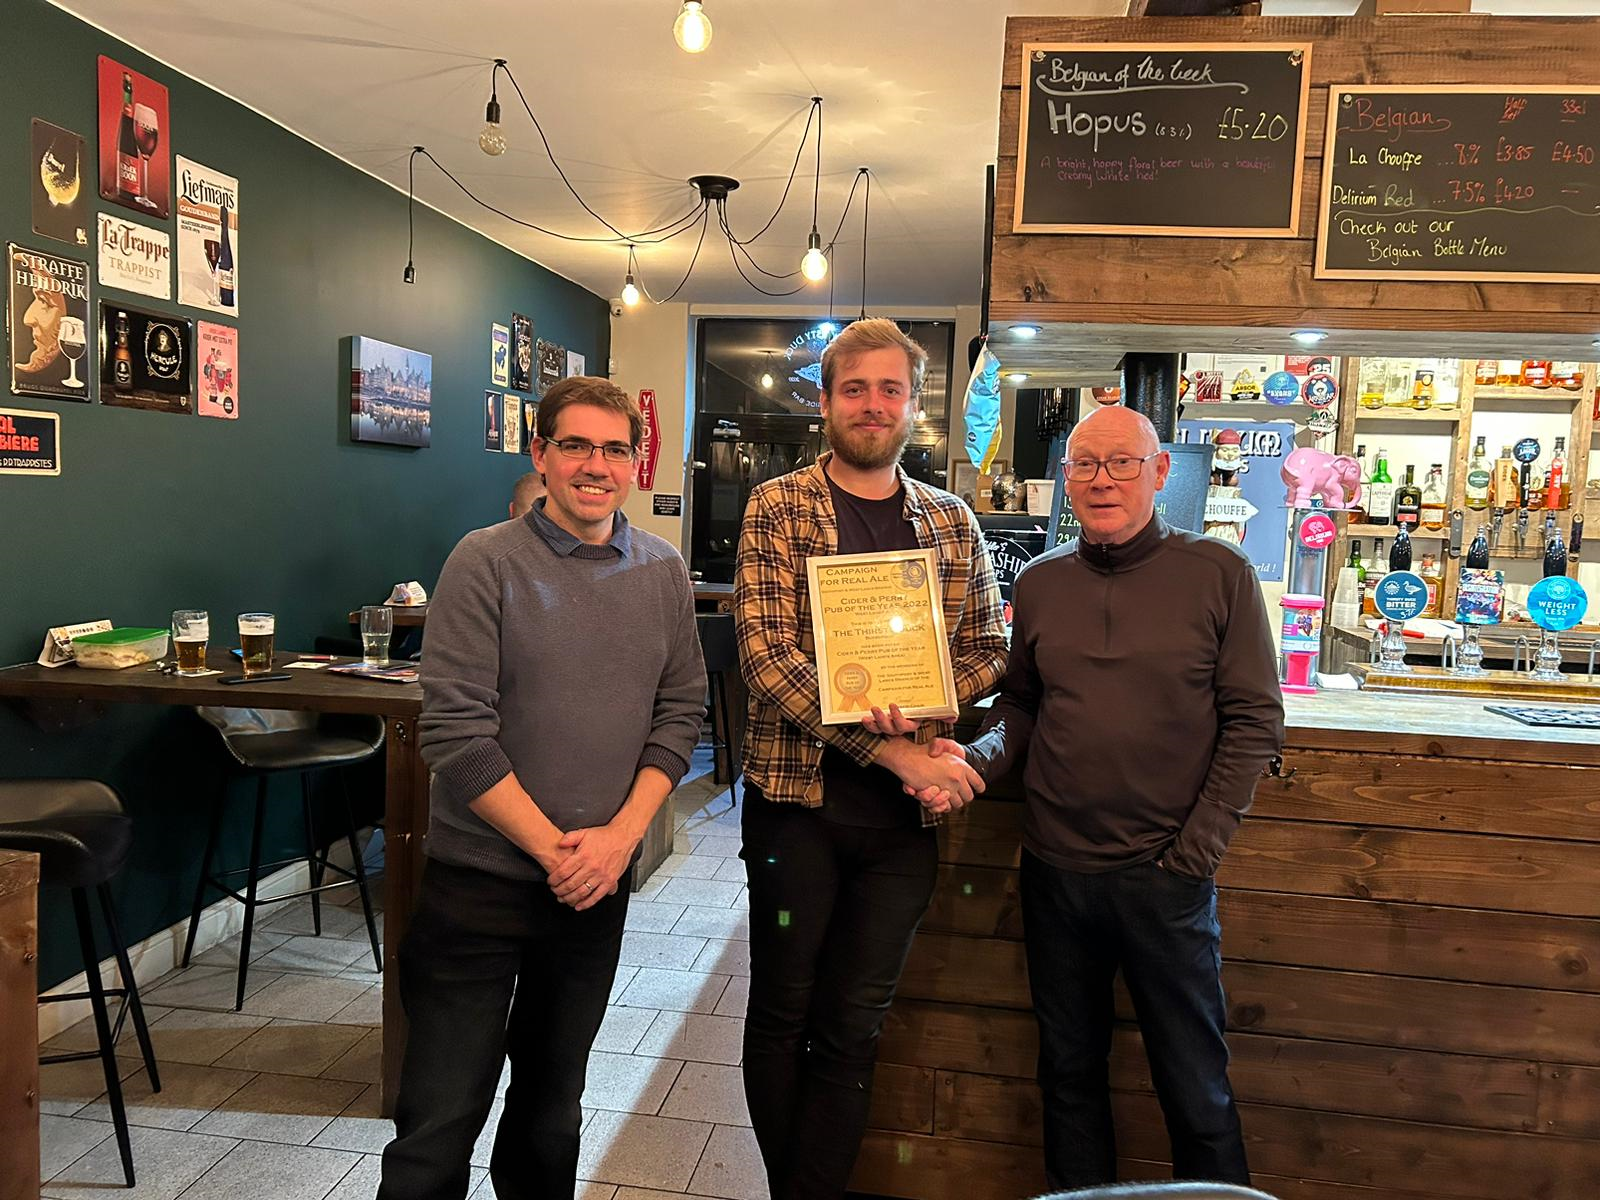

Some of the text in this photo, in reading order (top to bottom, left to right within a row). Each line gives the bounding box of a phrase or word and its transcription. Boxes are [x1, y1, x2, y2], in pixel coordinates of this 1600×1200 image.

[1049, 58, 1112, 92] Belgian
[1114, 63, 1130, 90] of
[1137, 55, 1165, 81] the
[1047, 99, 1147, 152] Hopus
[1354, 97, 1435, 143] Belgian
[1349, 147, 1368, 165] La
[1378, 147, 1423, 172] Chouffe
[180, 168, 235, 210] Liefmans
[1332, 184, 1378, 207] Delirium
[1383, 183, 1416, 208] Red
[1340, 217, 1455, 236] Check out our
[98, 217, 171, 263] La Trappe
[1366, 236, 1508, 266] Belgian Bottle Menu
[21, 253, 84, 281] STRAFFE
[108, 256, 162, 281] TRAPPIST
[640, 394, 653, 486] VEDETT
[1205, 504, 1247, 516] CHOUFFE
[820, 574, 889, 587] FOR REAL ALE
[825, 566, 878, 576] CAMPAIGN
[824, 606, 843, 614] PUB
[858, 603, 876, 611] THE
[903, 599, 929, 608] 2022
[840, 597, 868, 605] CIDER
[869, 595, 877, 603] &
[1538, 600, 1577, 611] WEIGHT
[1545, 607, 1568, 617] LESS
[832, 629, 854, 637] THE
[901, 623, 926, 632] UCK
